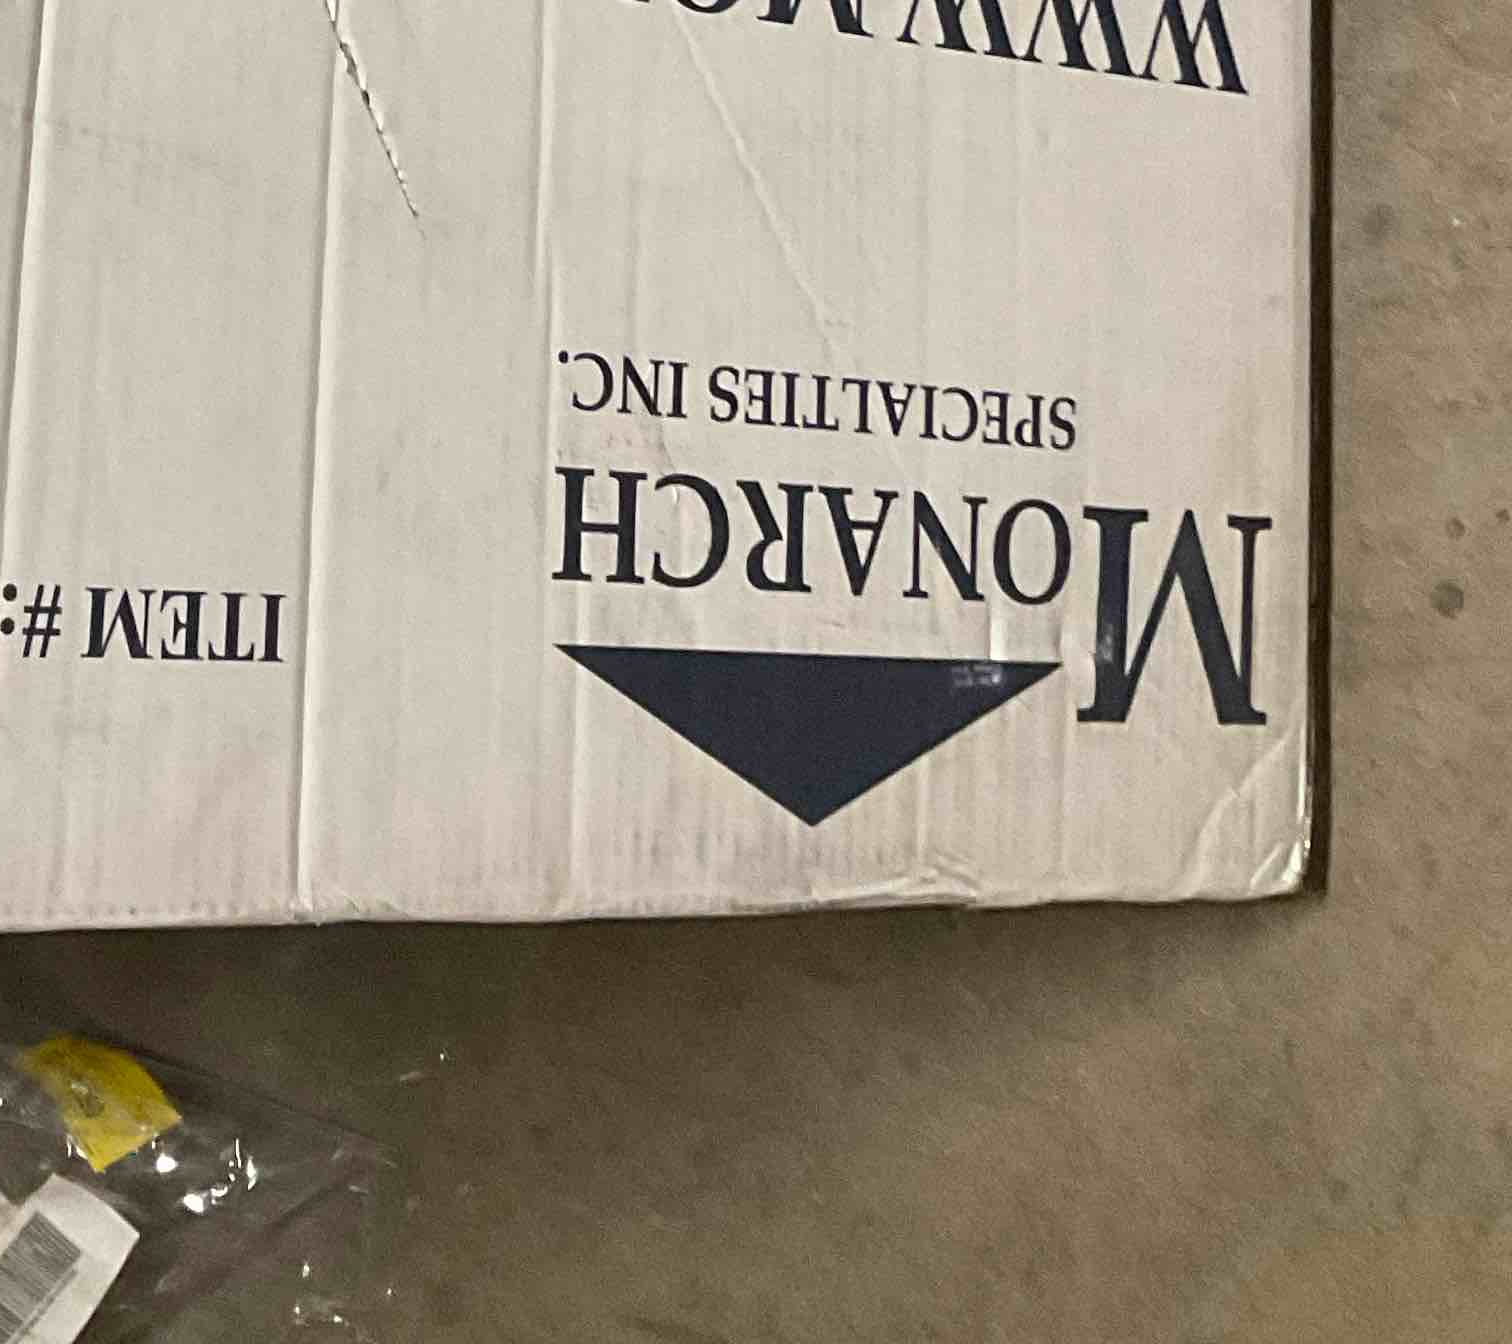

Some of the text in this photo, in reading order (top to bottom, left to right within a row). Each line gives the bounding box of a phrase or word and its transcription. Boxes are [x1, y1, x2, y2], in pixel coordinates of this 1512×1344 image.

[556, 350, 1077, 451] SPECIALTIES INC.
[81, 588, 286, 663] ITEM
